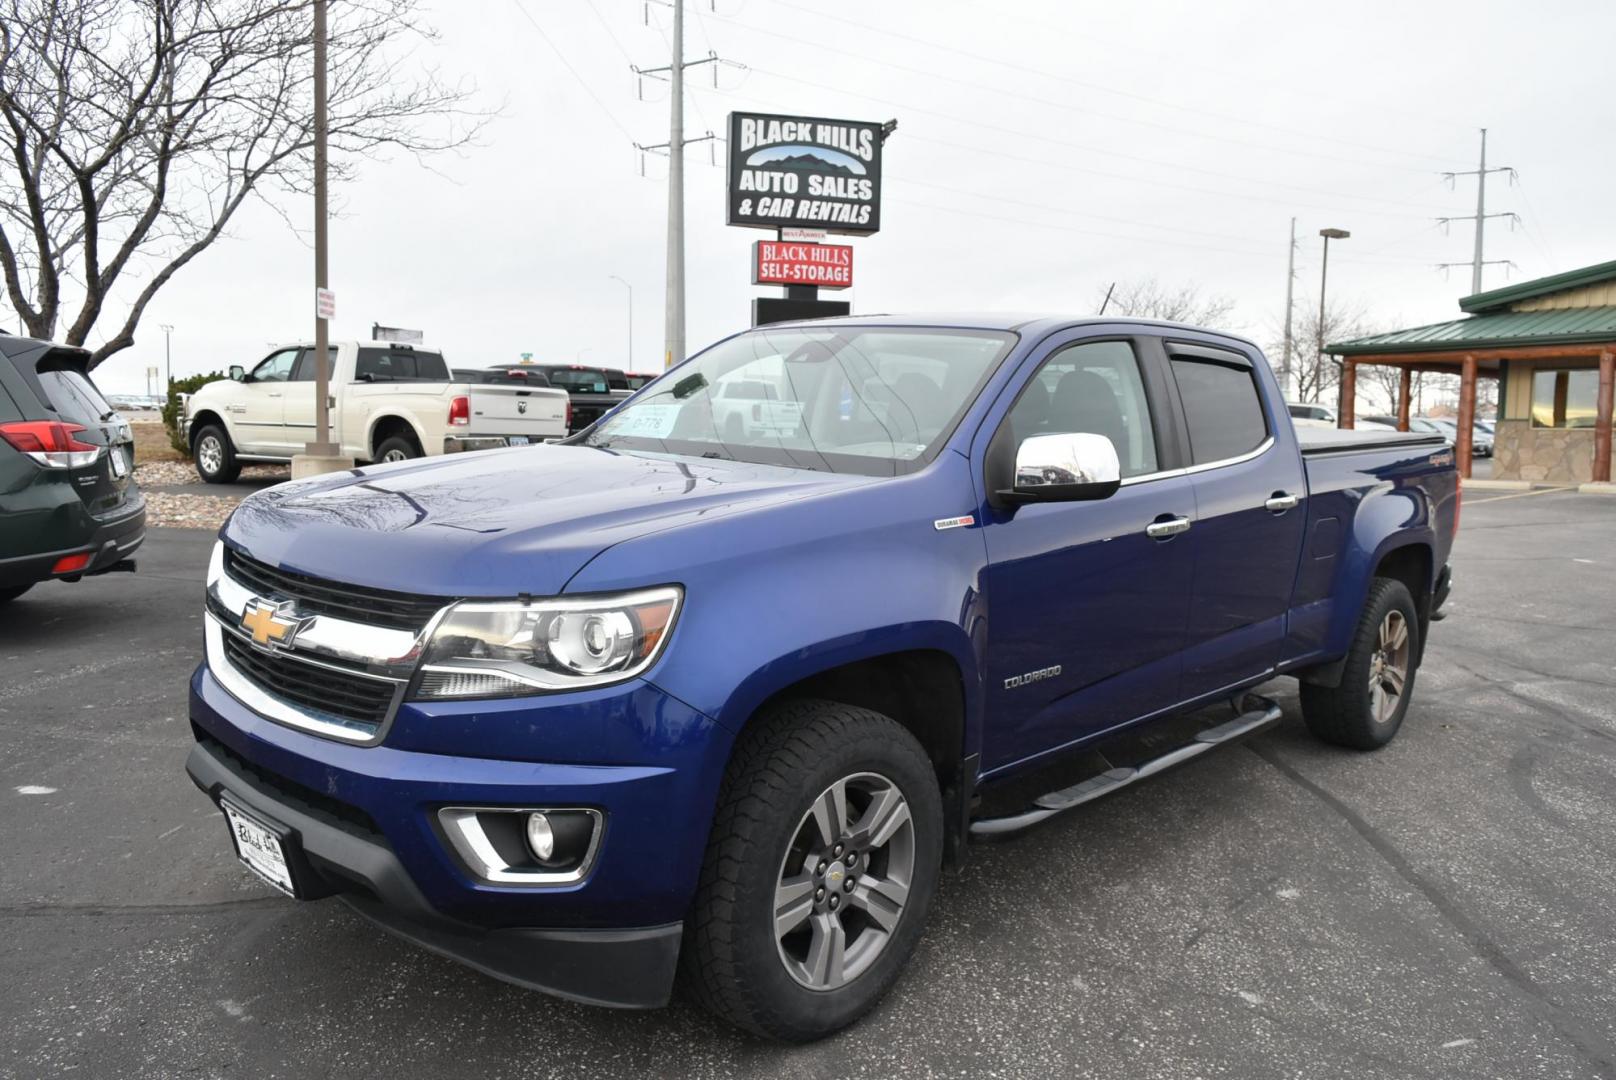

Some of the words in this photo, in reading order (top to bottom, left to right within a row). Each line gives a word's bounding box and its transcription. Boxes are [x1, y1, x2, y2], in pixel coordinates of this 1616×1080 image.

[741, 118, 812, 152] BLACK
[816, 124, 873, 161] HILLS
[739, 169, 799, 194] AUTO
[808, 174, 873, 200] SALES
[738, 198, 752, 216] &
[756, 197, 795, 218] CAR
[796, 199, 872, 224] RENTALS
[763, 244, 808, 261] BLACK
[811, 247, 849, 266] HILLS
[761, 262, 849, 282] SELF-STORAGE
[1004, 664, 1062, 689] COLORADO
